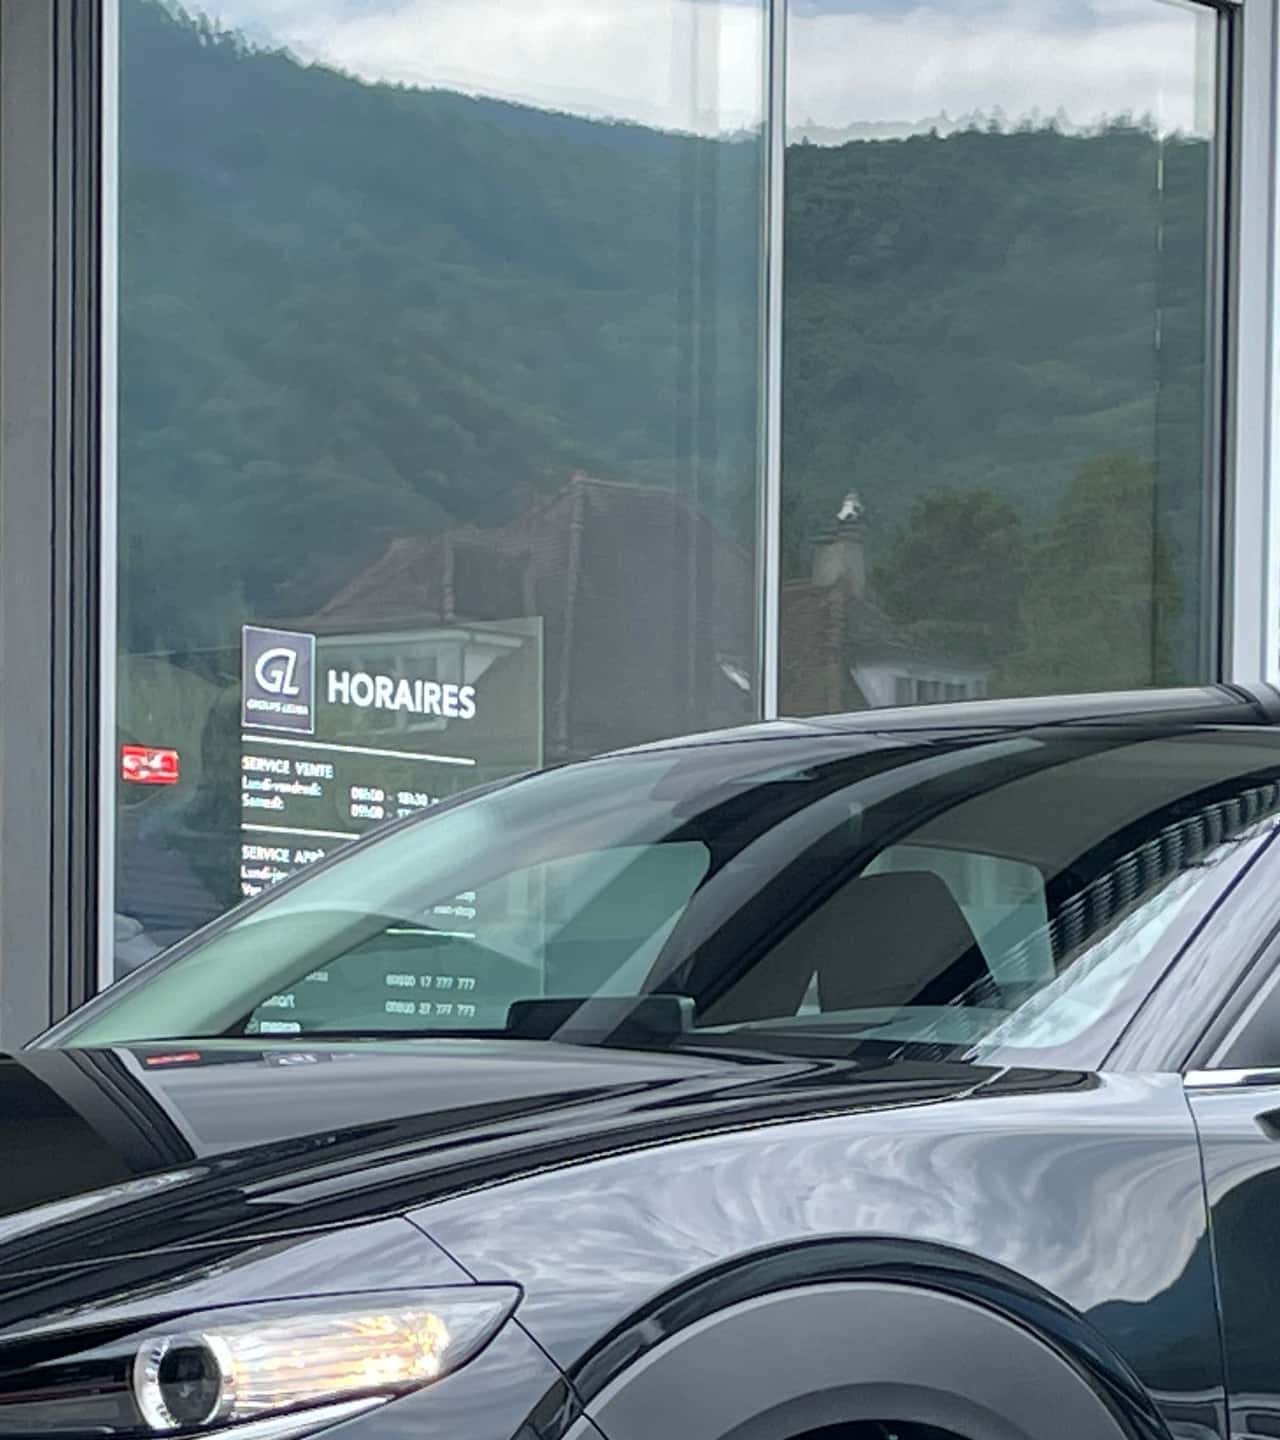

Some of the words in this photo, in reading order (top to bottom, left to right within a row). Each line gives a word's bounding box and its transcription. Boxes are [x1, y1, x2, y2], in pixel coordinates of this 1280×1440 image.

[255, 647, 300, 695] GL
[327, 669, 477, 720] HORAIRES
[241, 755, 291, 775] SERVICE
[295, 761, 335, 779] VENTE
[241, 845, 291, 864] SERVICE
